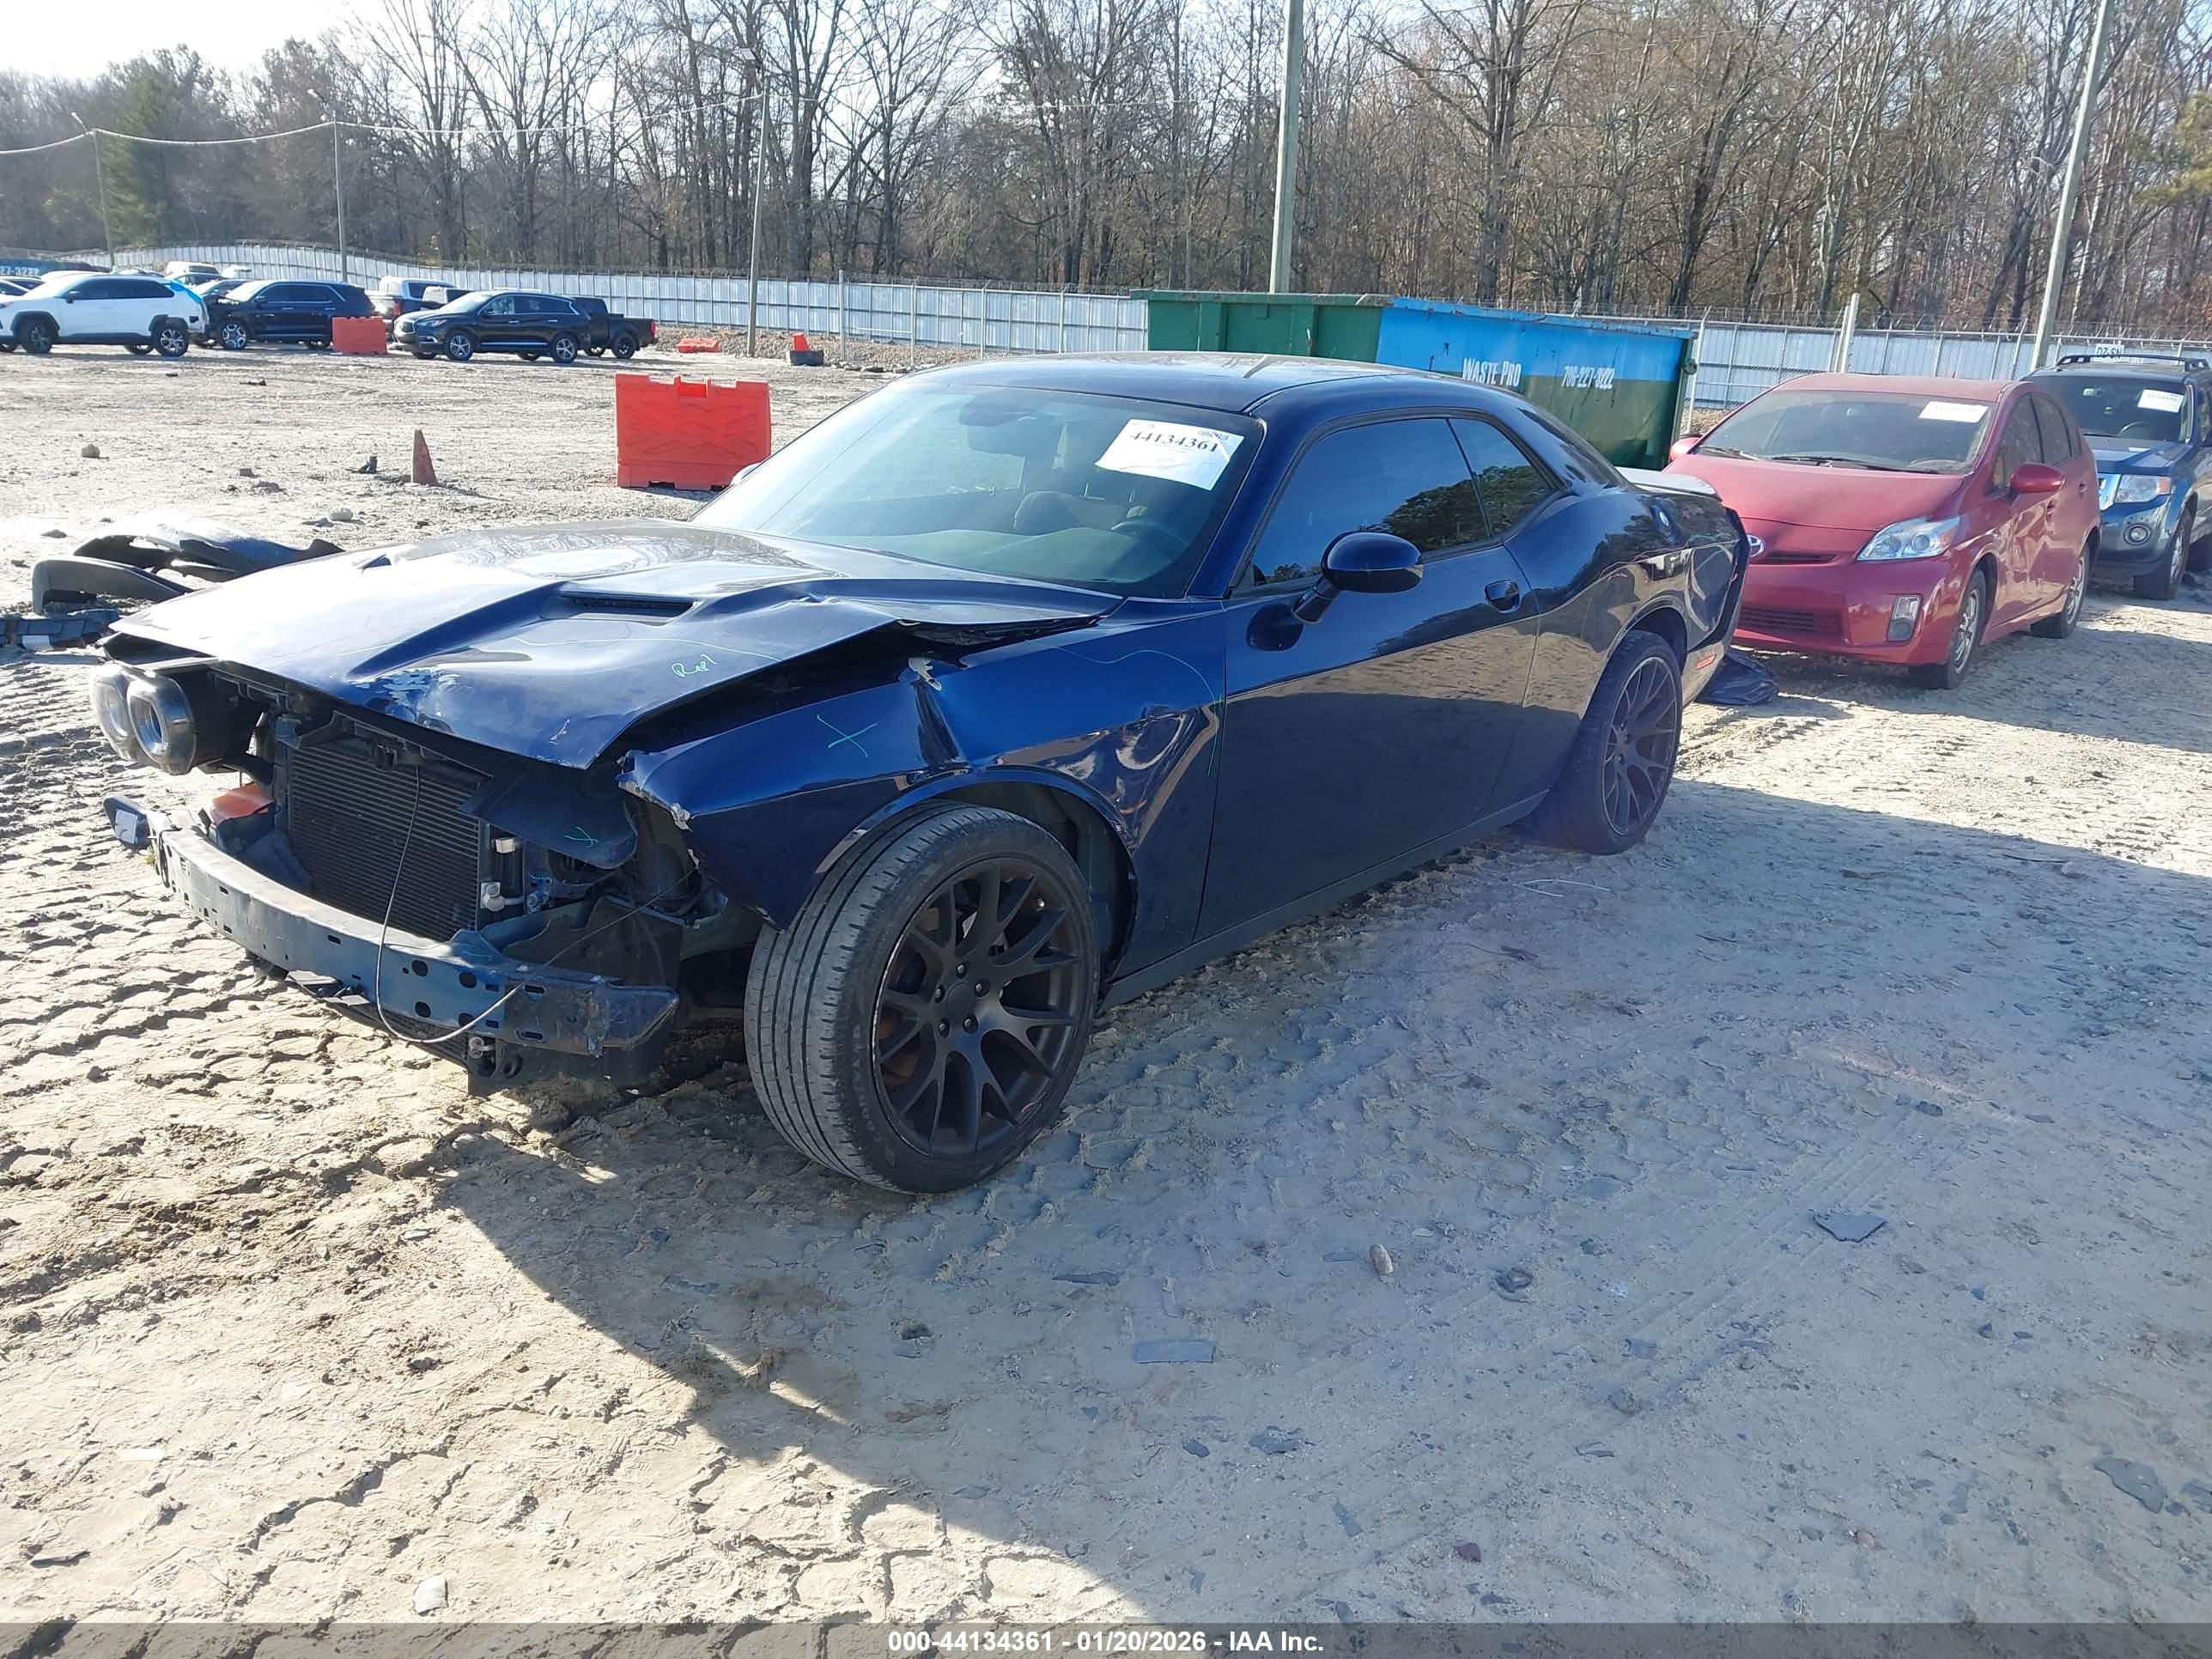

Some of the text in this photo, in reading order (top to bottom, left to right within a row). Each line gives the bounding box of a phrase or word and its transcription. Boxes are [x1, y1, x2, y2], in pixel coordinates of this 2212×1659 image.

[1462, 357, 1522, 387] WASTE PRO
[1130, 431, 1218, 452] 44134361
